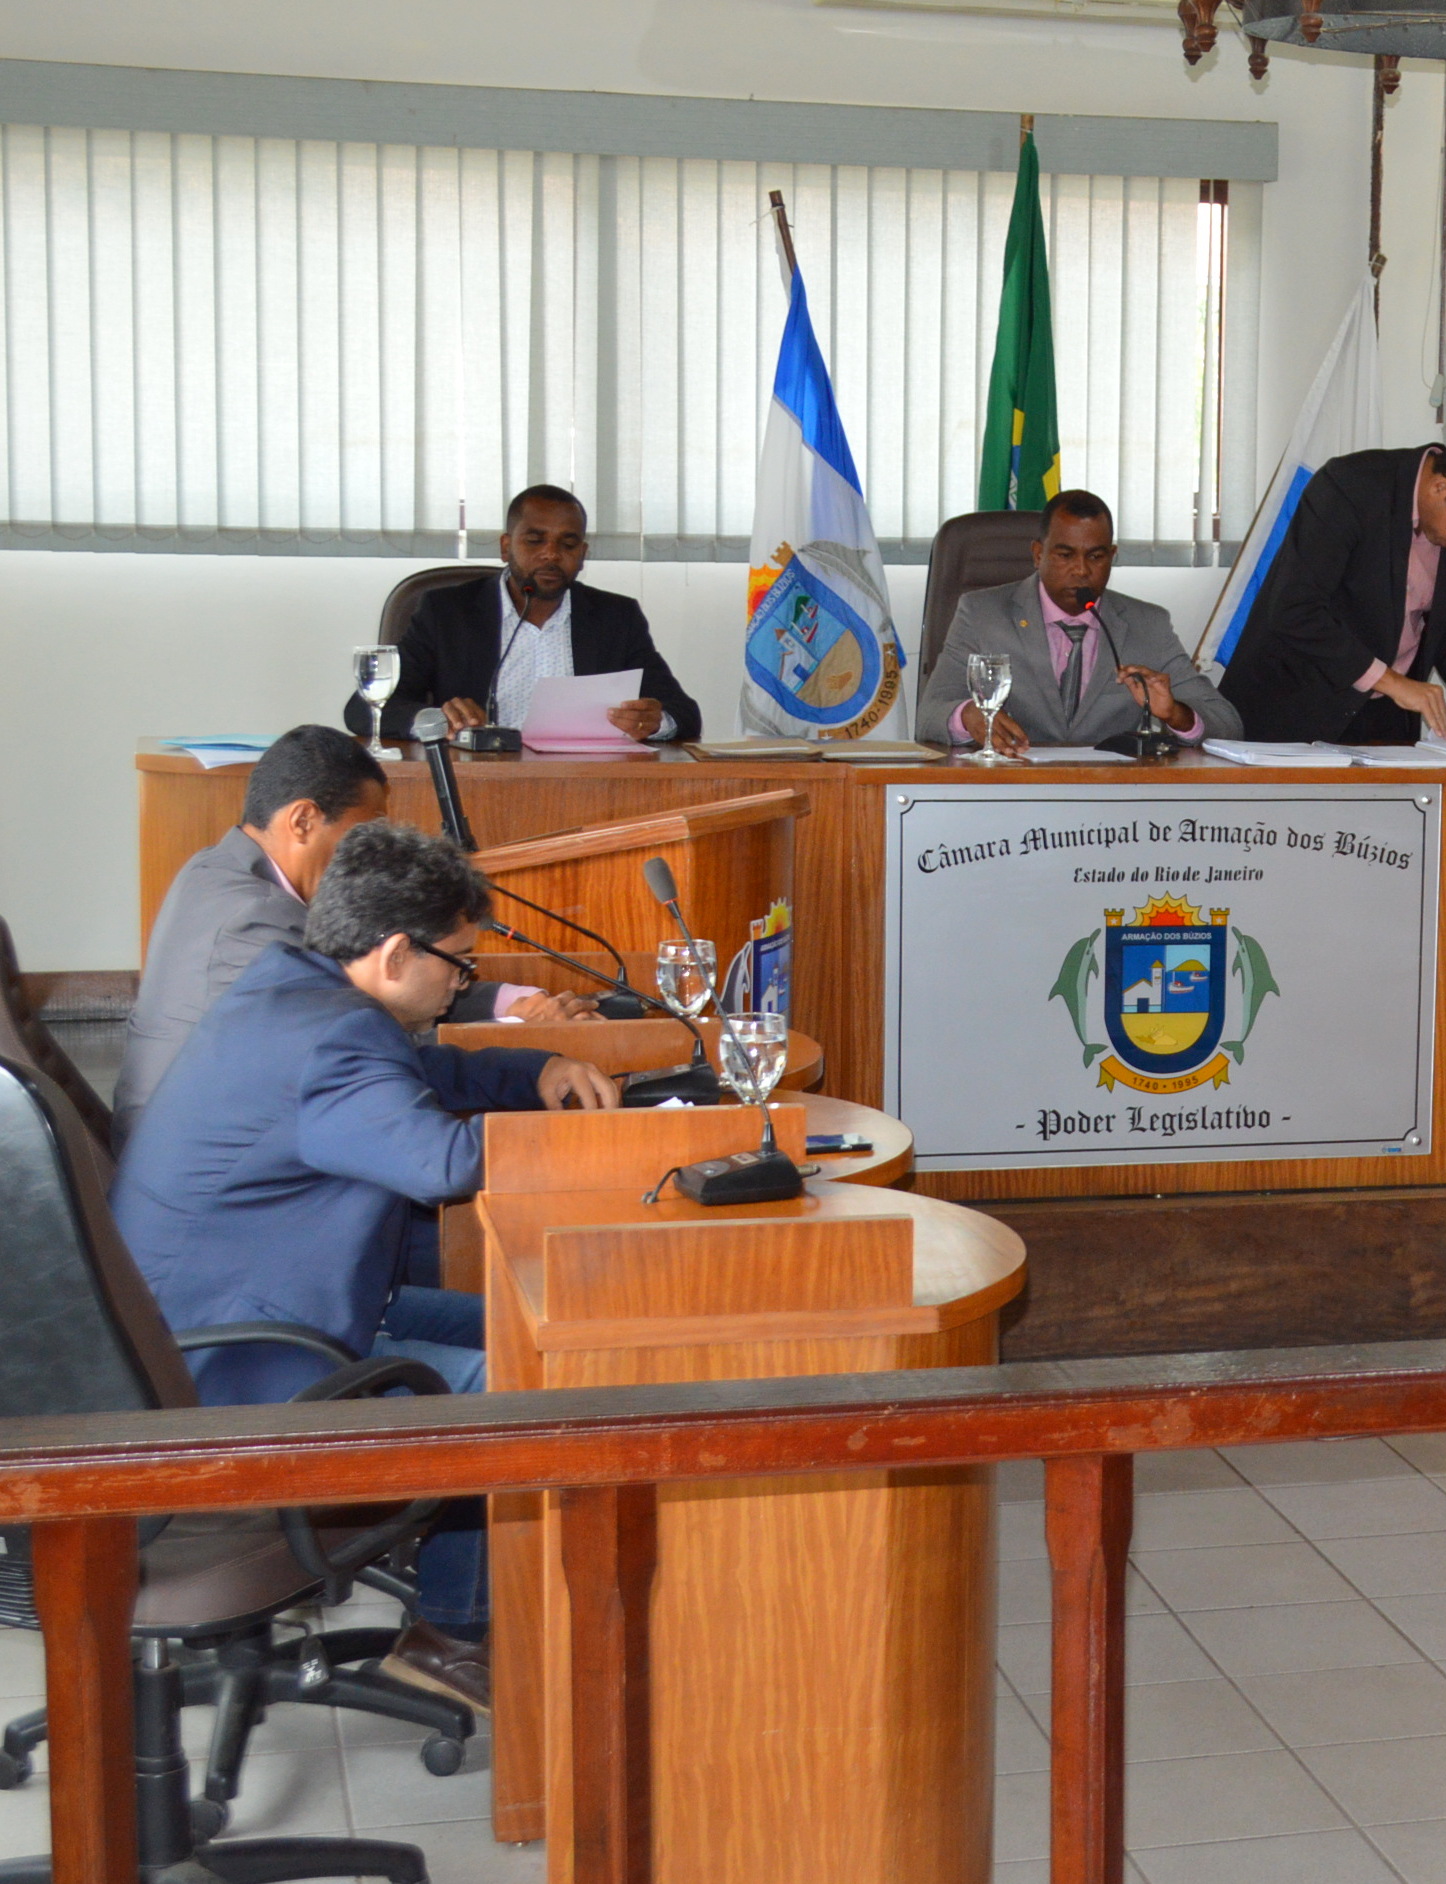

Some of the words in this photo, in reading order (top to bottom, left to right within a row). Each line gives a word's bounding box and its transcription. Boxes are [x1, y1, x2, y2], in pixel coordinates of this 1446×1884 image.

[845, 711, 879, 739] 1740
[878, 670, 900, 706] 1995
[917, 837, 1012, 874] Câmara
[1019, 820, 1140, 855] Municipal
[1149, 820, 1173, 843] de
[1178, 818, 1278, 853] Armação
[1286, 826, 1326, 851] dos
[1331, 830, 1414, 871] Búzios
[1073, 866, 1125, 883] Estado
[1130, 866, 1149, 882] do
[1204, 865, 1264, 883] Janeiro
[1121, 931, 1162, 942] ARMAÇÃO
[1164, 932, 1181, 940] DOS
[1183, 931, 1212, 940] BÚZIOS
[1132, 1077, 1159, 1090] 1740
[1172, 1075, 1199, 1089] 1995
[1035, 1109, 1117, 1141] Poder
[1126, 1103, 1271, 1137] Legislativo
